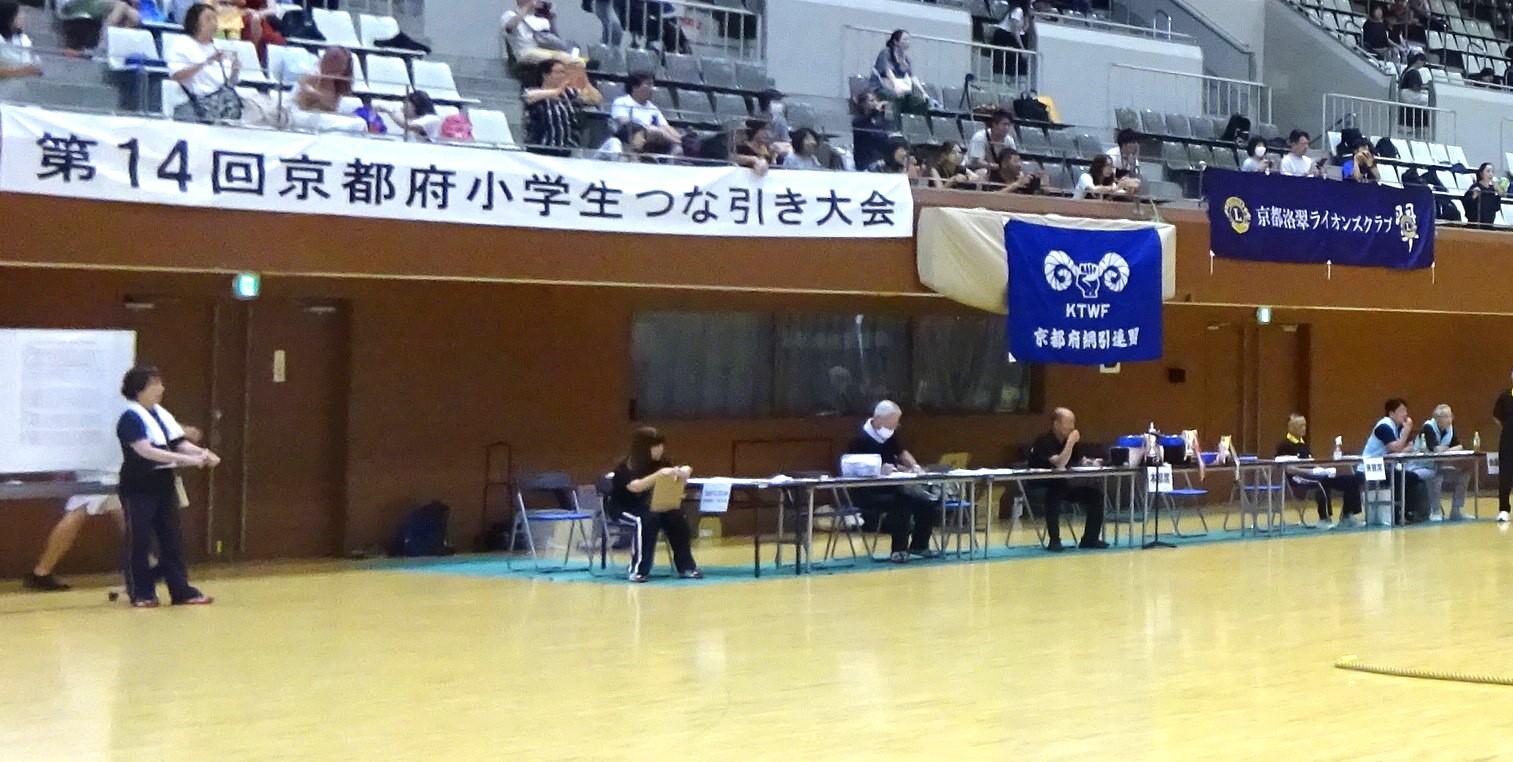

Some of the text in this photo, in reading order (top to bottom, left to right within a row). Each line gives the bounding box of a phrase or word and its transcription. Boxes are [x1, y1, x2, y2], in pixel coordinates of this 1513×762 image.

[36, 132, 896, 228] 第14回京都府小学生つな引き大会
[1066, 303, 1110, 318] KTWF
